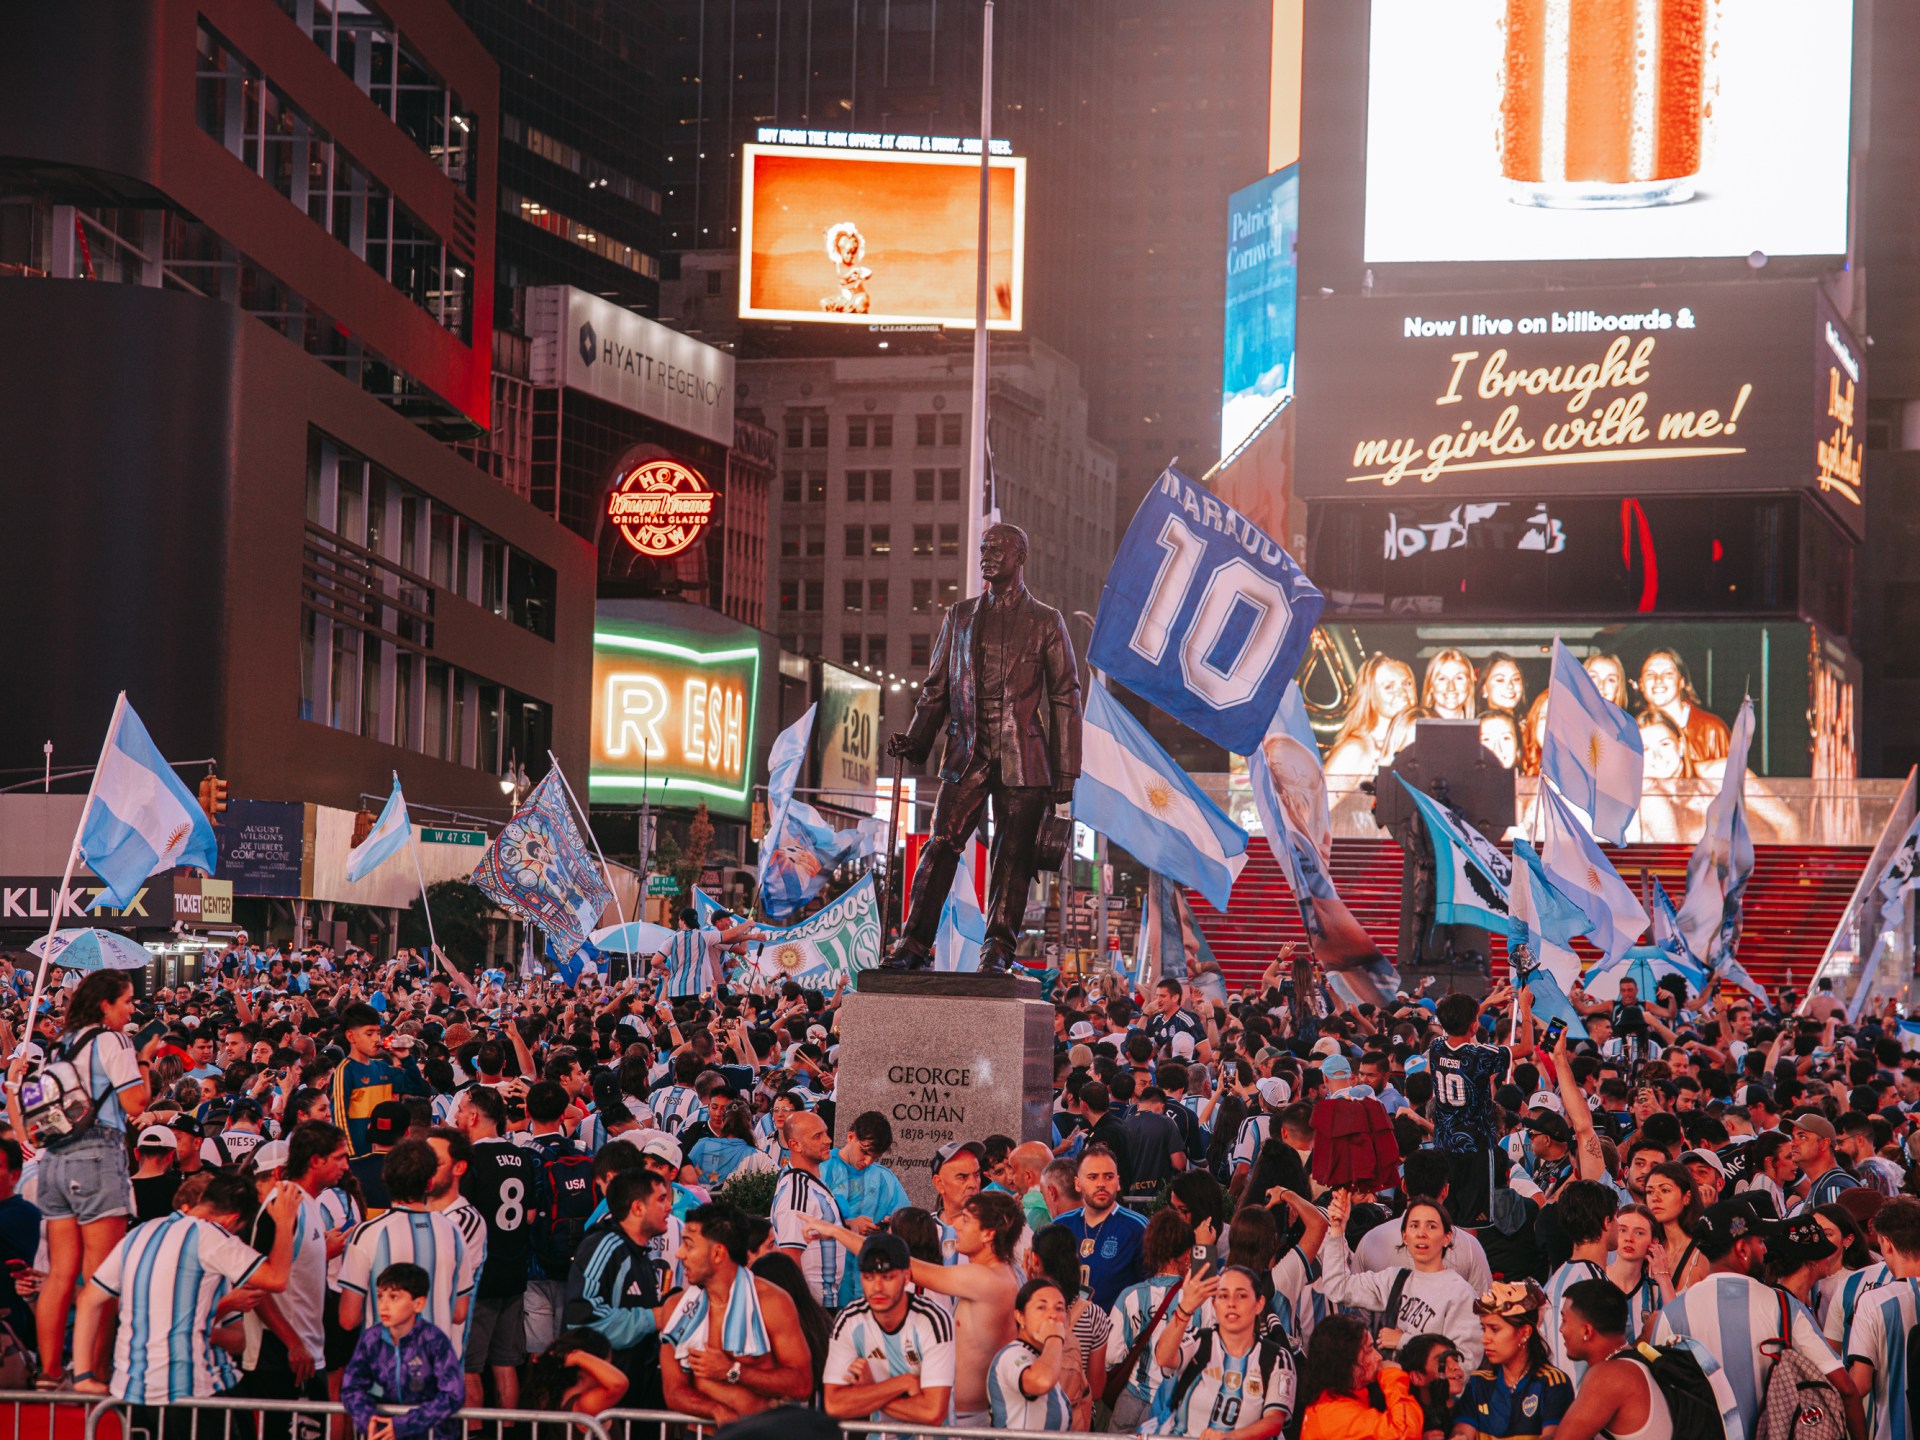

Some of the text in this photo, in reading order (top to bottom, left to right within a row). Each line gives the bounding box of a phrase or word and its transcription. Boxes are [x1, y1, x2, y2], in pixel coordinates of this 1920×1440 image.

[807, 130, 827, 146] THE
[848, 133, 882, 149] OFFICE
[921, 137, 931, 151] &
[1231, 198, 1279, 242] Patricia
[1226, 223, 1283, 277] Cornwell
[1404, 306, 1696, 338] Now I live on billboards &
[602, 338, 724, 408] HYATT REGENCY
[1435, 335, 1656, 414] I brought
[1352, 435, 1424, 487] my
[1420, 404, 1537, 484] girls
[1541, 391, 1651, 452] with
[1656, 383, 1754, 443] me!
[638, 467, 685, 489] HOT
[612, 515, 708, 525] ORIGINAL GLAZED
[635, 526, 685, 549] NOW
[1128, 512, 1293, 711] 10
[841, 705, 872, 762] 120
[841, 757, 871, 785] YEARS
[240, 832, 284, 841] WILSON'S
[245, 825, 280, 833] AUGUST
[435, 831, 471, 843] W 47 St
[231, 849, 256, 860] COME
[265, 851, 290, 861] GONE
[239, 842, 284, 852] JOE TURNER'S
[662, 877, 669, 885] 47
[174, 893, 231, 915] TICKET CENTER
[1439, 1057, 1461, 1069] MESSI
[888, 1066, 970, 1086] GEORGE
[919, 1087, 939, 1104] M
[1435, 1071, 1467, 1107] 10
[892, 1104, 965, 1124] COHAN
[900, 1128, 953, 1144] 1878-1942
[495, 1154, 522, 1167] ENZO
[880, 1158, 895, 1168] my
[565, 1178, 586, 1190] USA
[495, 1177, 525, 1231] 8
